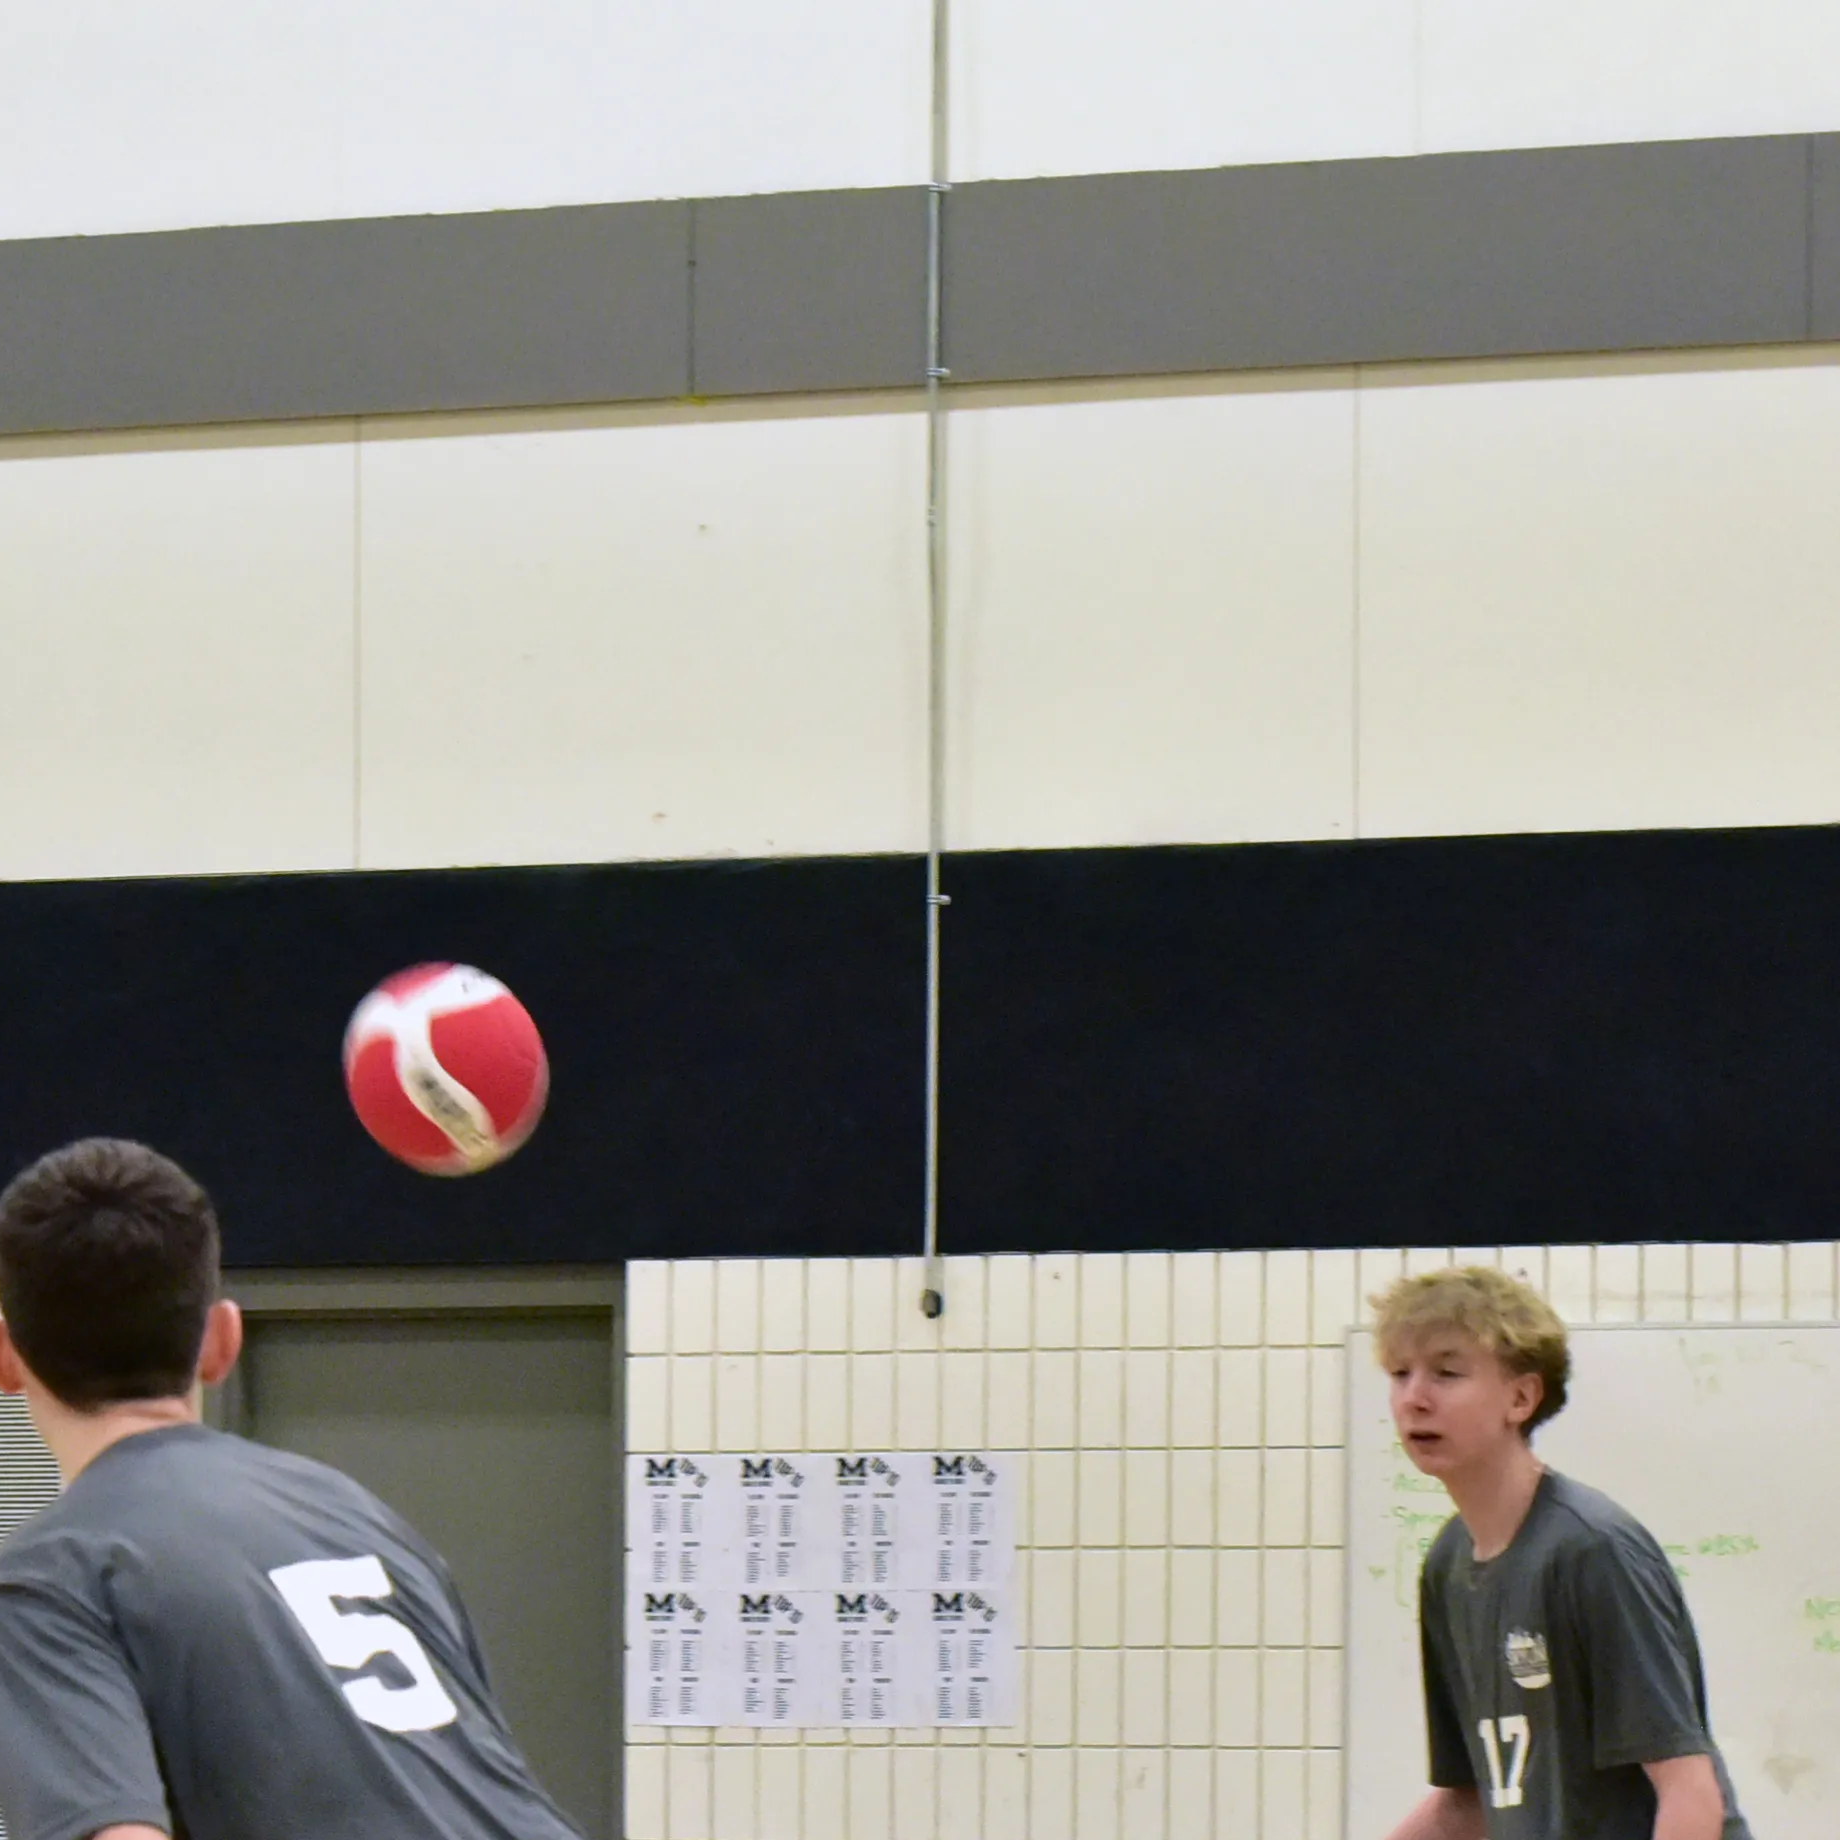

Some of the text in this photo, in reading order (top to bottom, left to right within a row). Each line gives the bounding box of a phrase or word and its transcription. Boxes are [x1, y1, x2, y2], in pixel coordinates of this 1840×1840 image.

[646, 1459, 677, 1478] M
[741, 1459, 772, 1478] M
[837, 1457, 868, 1477] M
[933, 1456, 964, 1475] M
[644, 1593, 675, 1613] M
[740, 1594, 770, 1614] M
[836, 1594, 867, 1614] M
[932, 1593, 963, 1612] M
[269, 1555, 458, 1734] 5
[1478, 1715, 1531, 1808] 17
